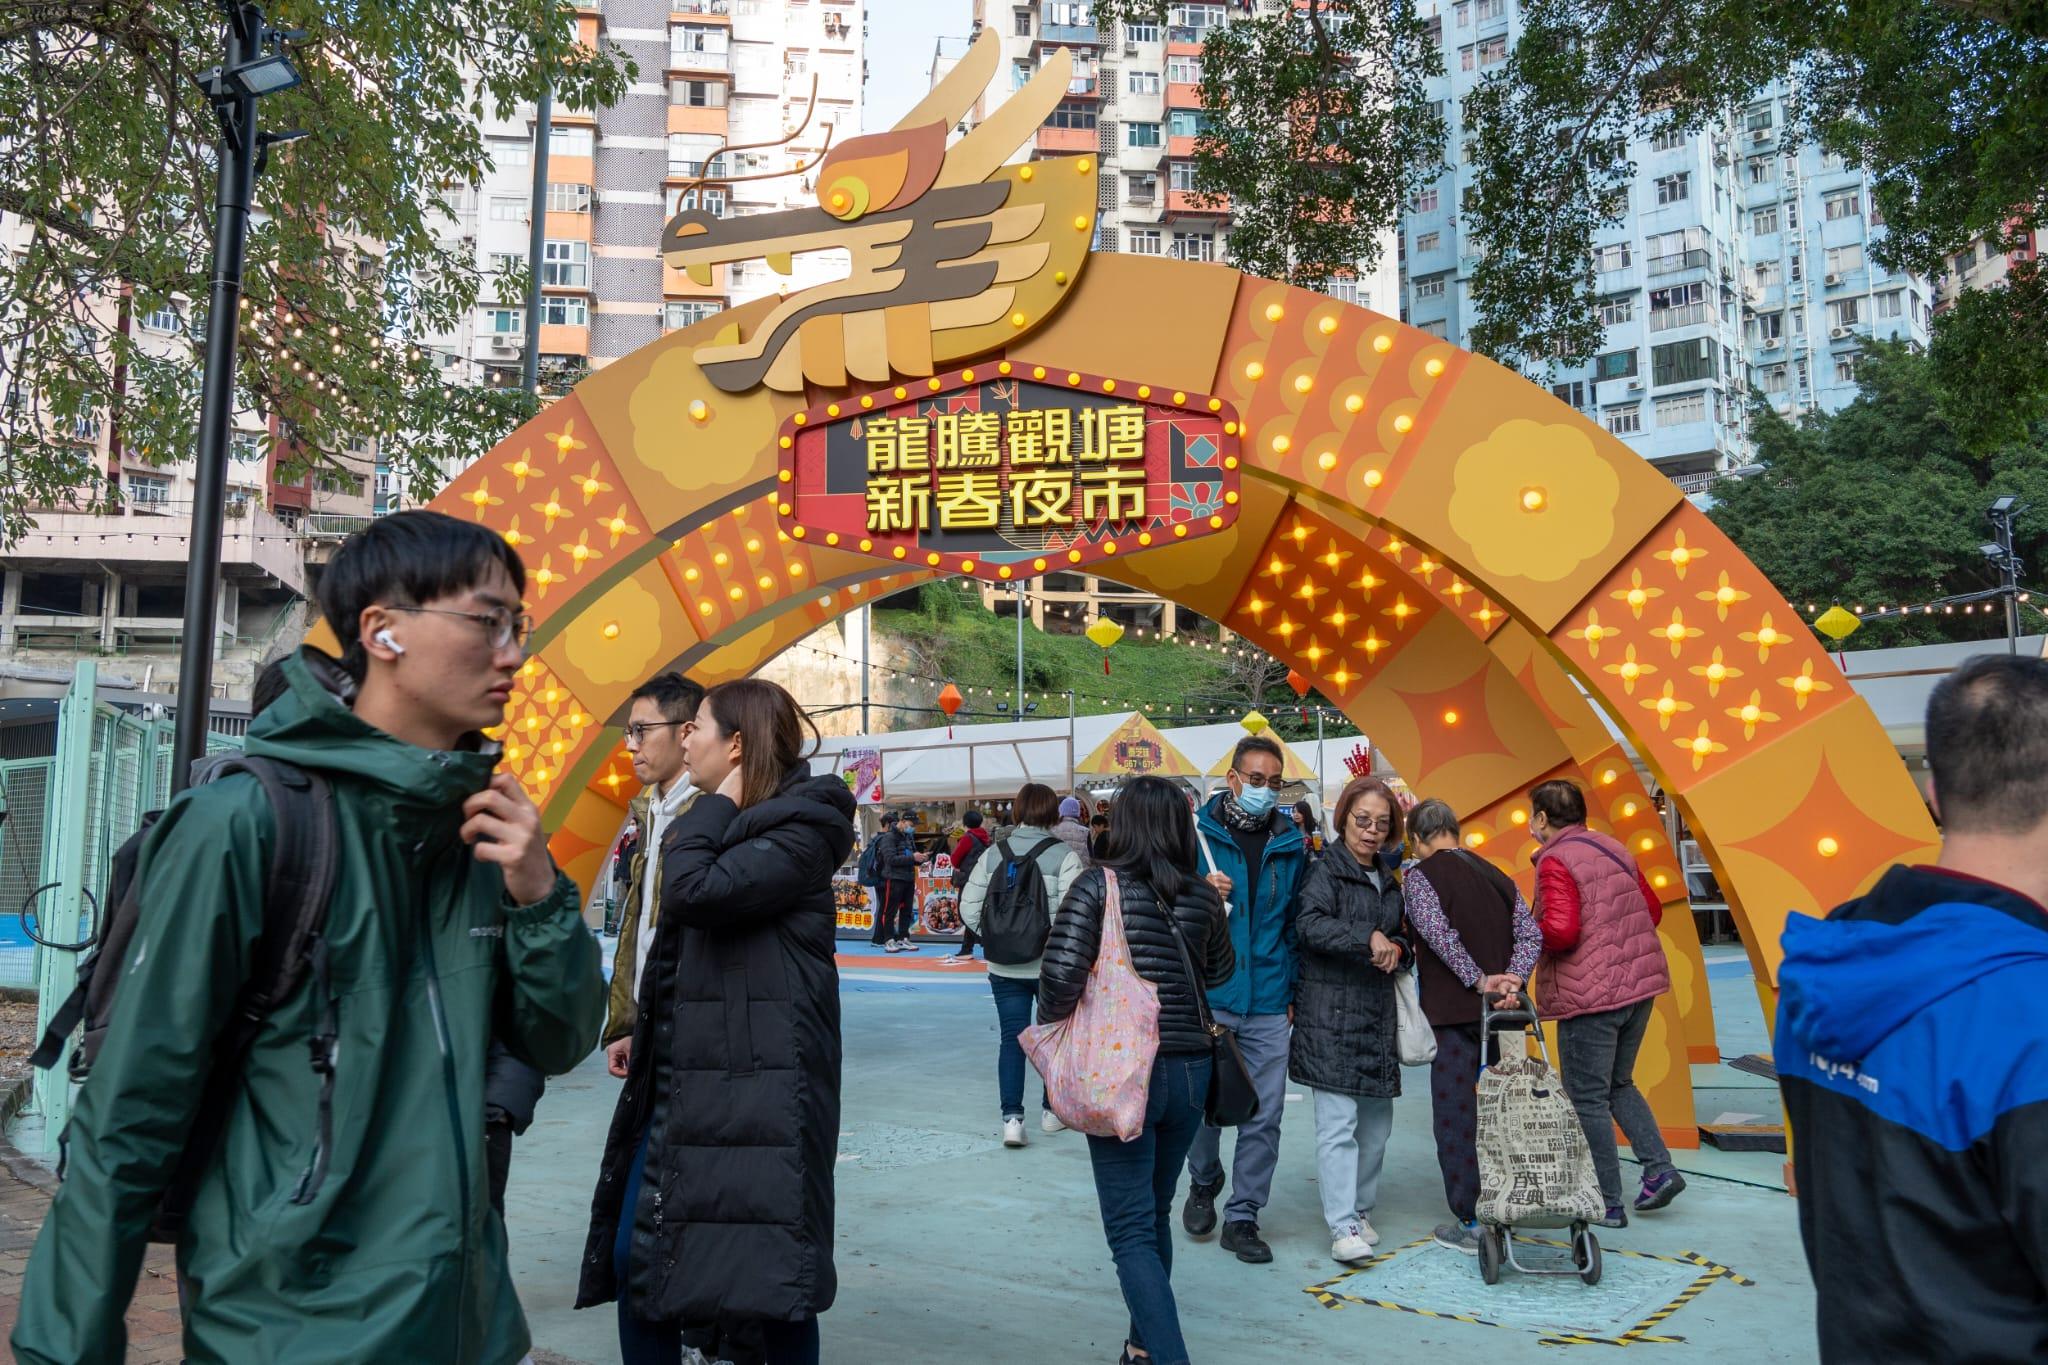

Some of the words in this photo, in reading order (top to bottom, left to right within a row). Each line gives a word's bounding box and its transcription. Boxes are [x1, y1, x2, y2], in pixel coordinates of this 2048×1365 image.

[865, 405, 1146, 473] 龍騰觀塘
[865, 467, 1146, 531] 新春夜市
[1523, 1121, 1537, 1130] SOY
[1538, 1120, 1559, 1130] SAUCE
[1528, 1153, 1556, 1164] CHUN
[1512, 1171, 1544, 1189] 百年
[1506, 1188, 1546, 1207] 經典
